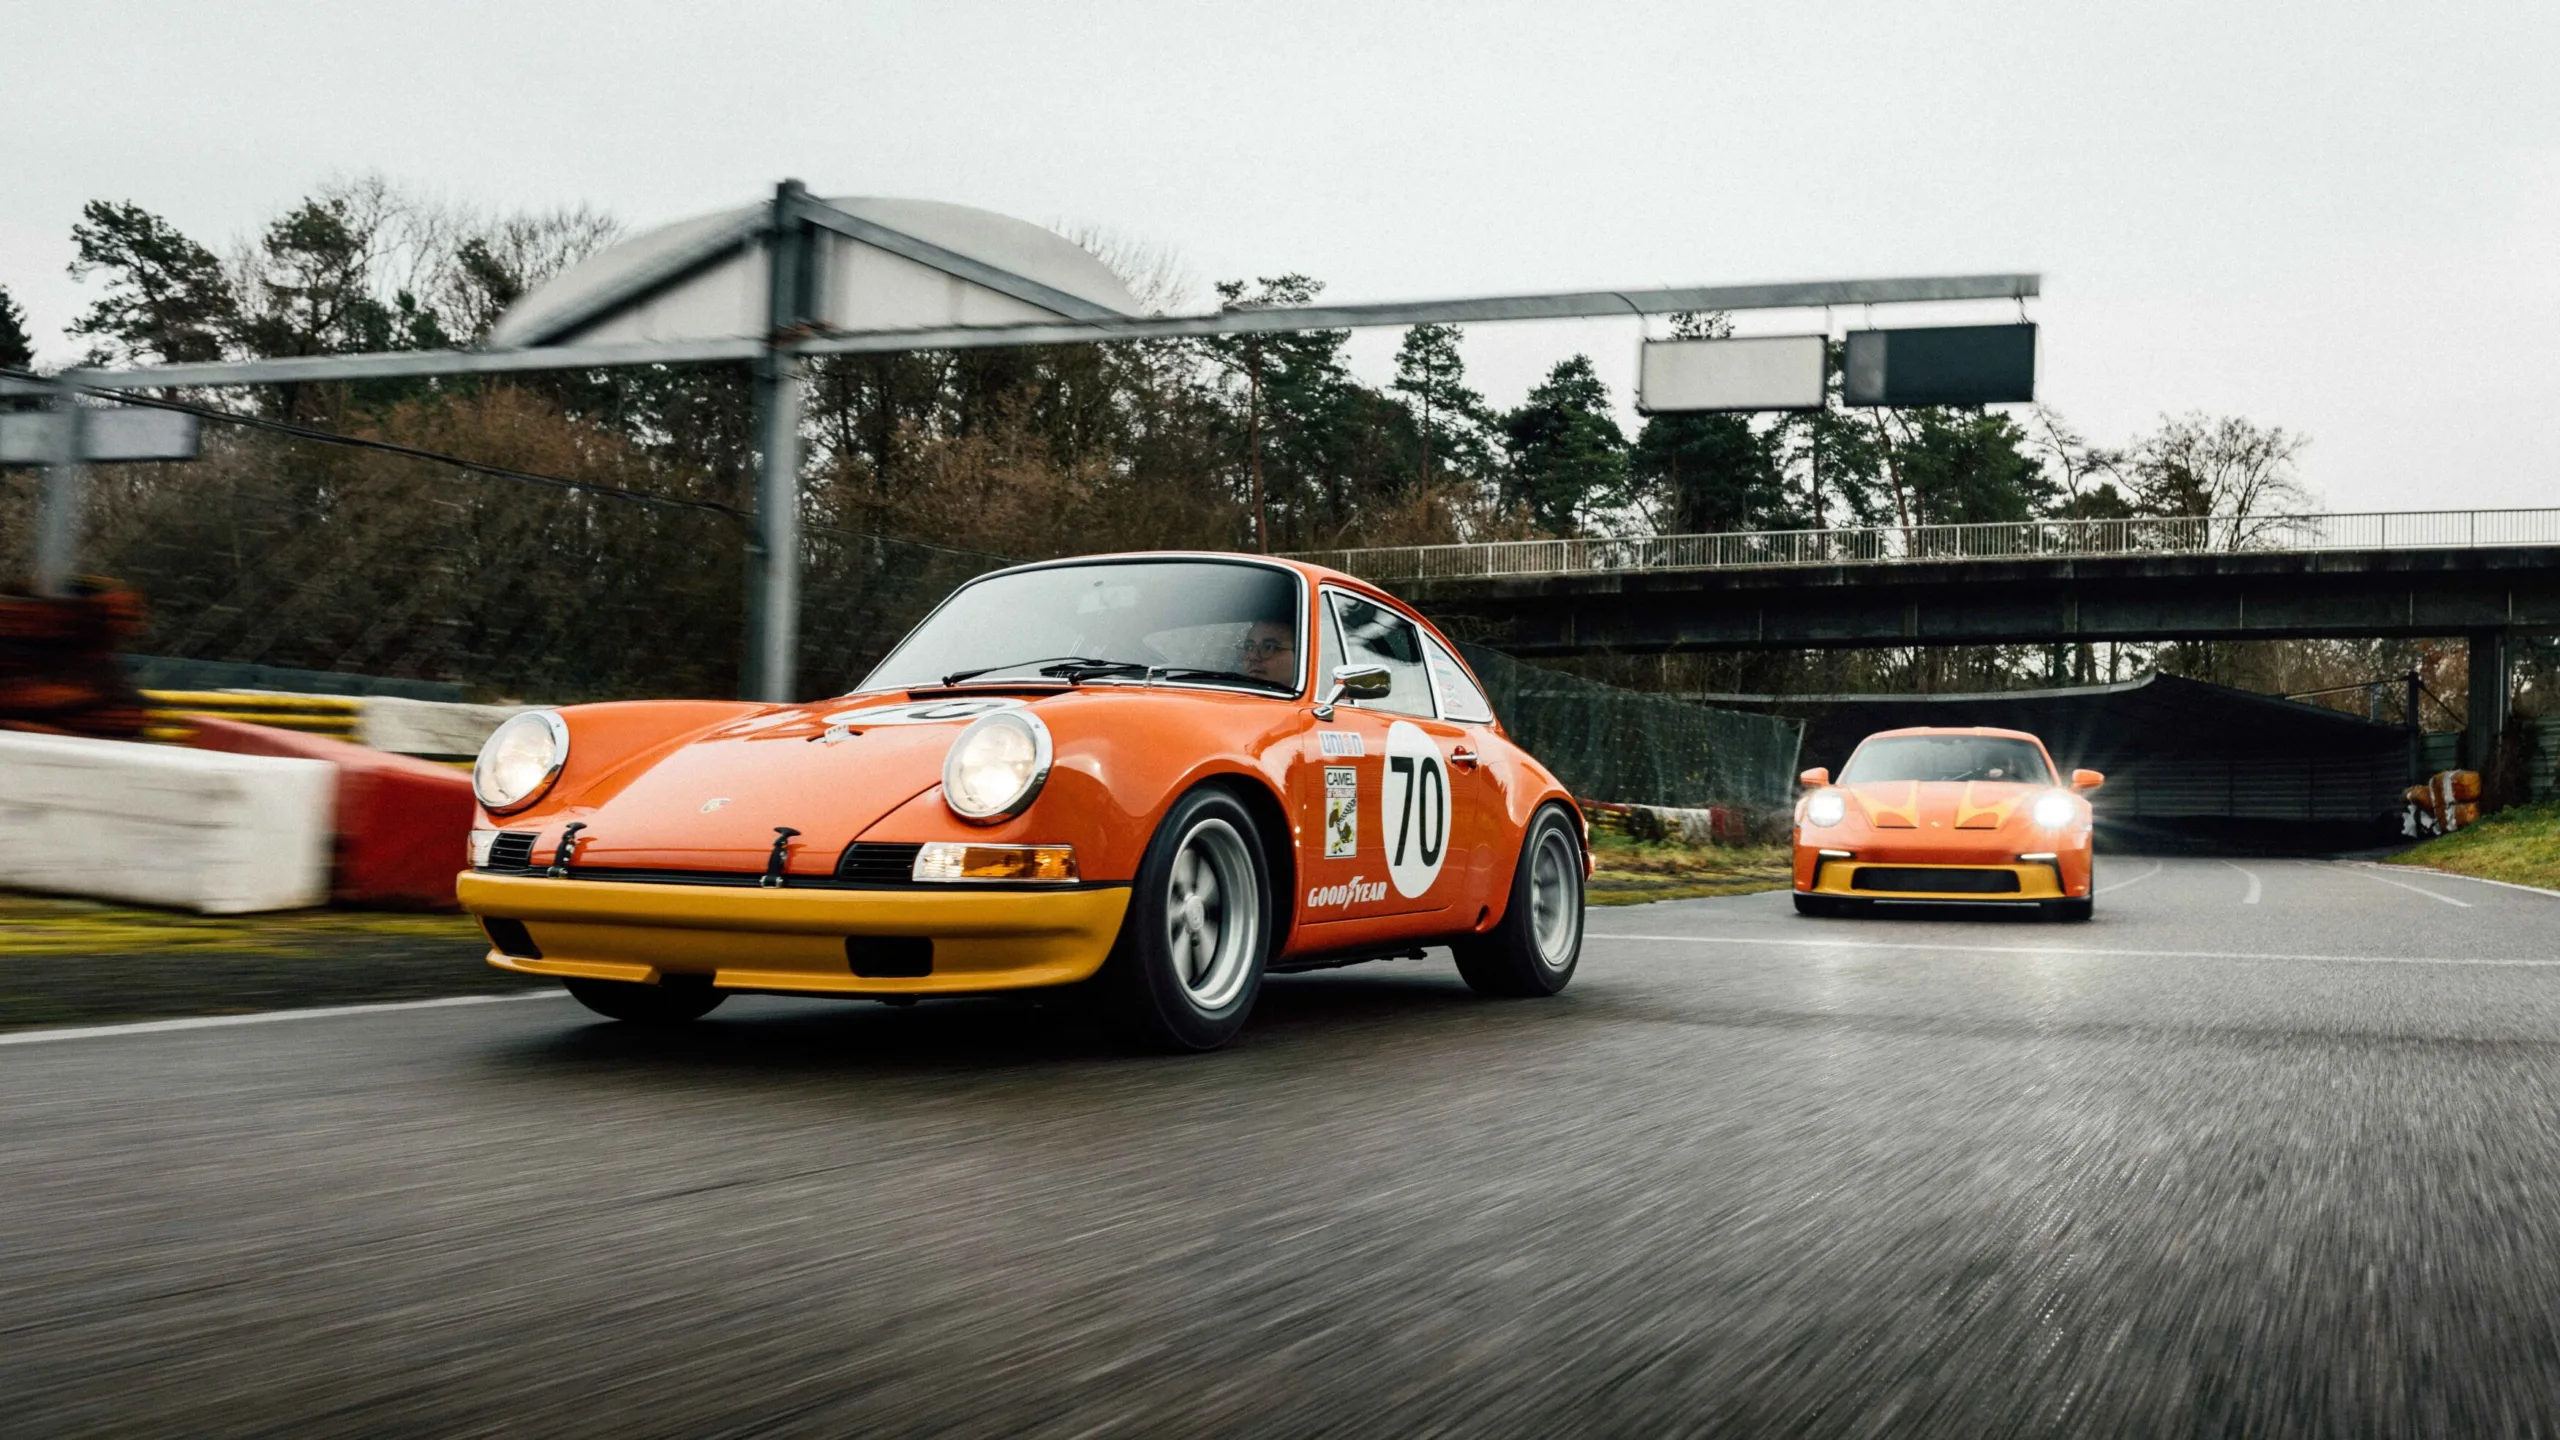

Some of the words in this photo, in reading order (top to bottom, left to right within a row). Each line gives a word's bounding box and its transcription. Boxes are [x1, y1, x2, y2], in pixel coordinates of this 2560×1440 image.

[1326, 772, 1356, 786] CAMEL
[1390, 756, 1443, 867] 70
[1307, 875, 1387, 911] GOODYEAR
